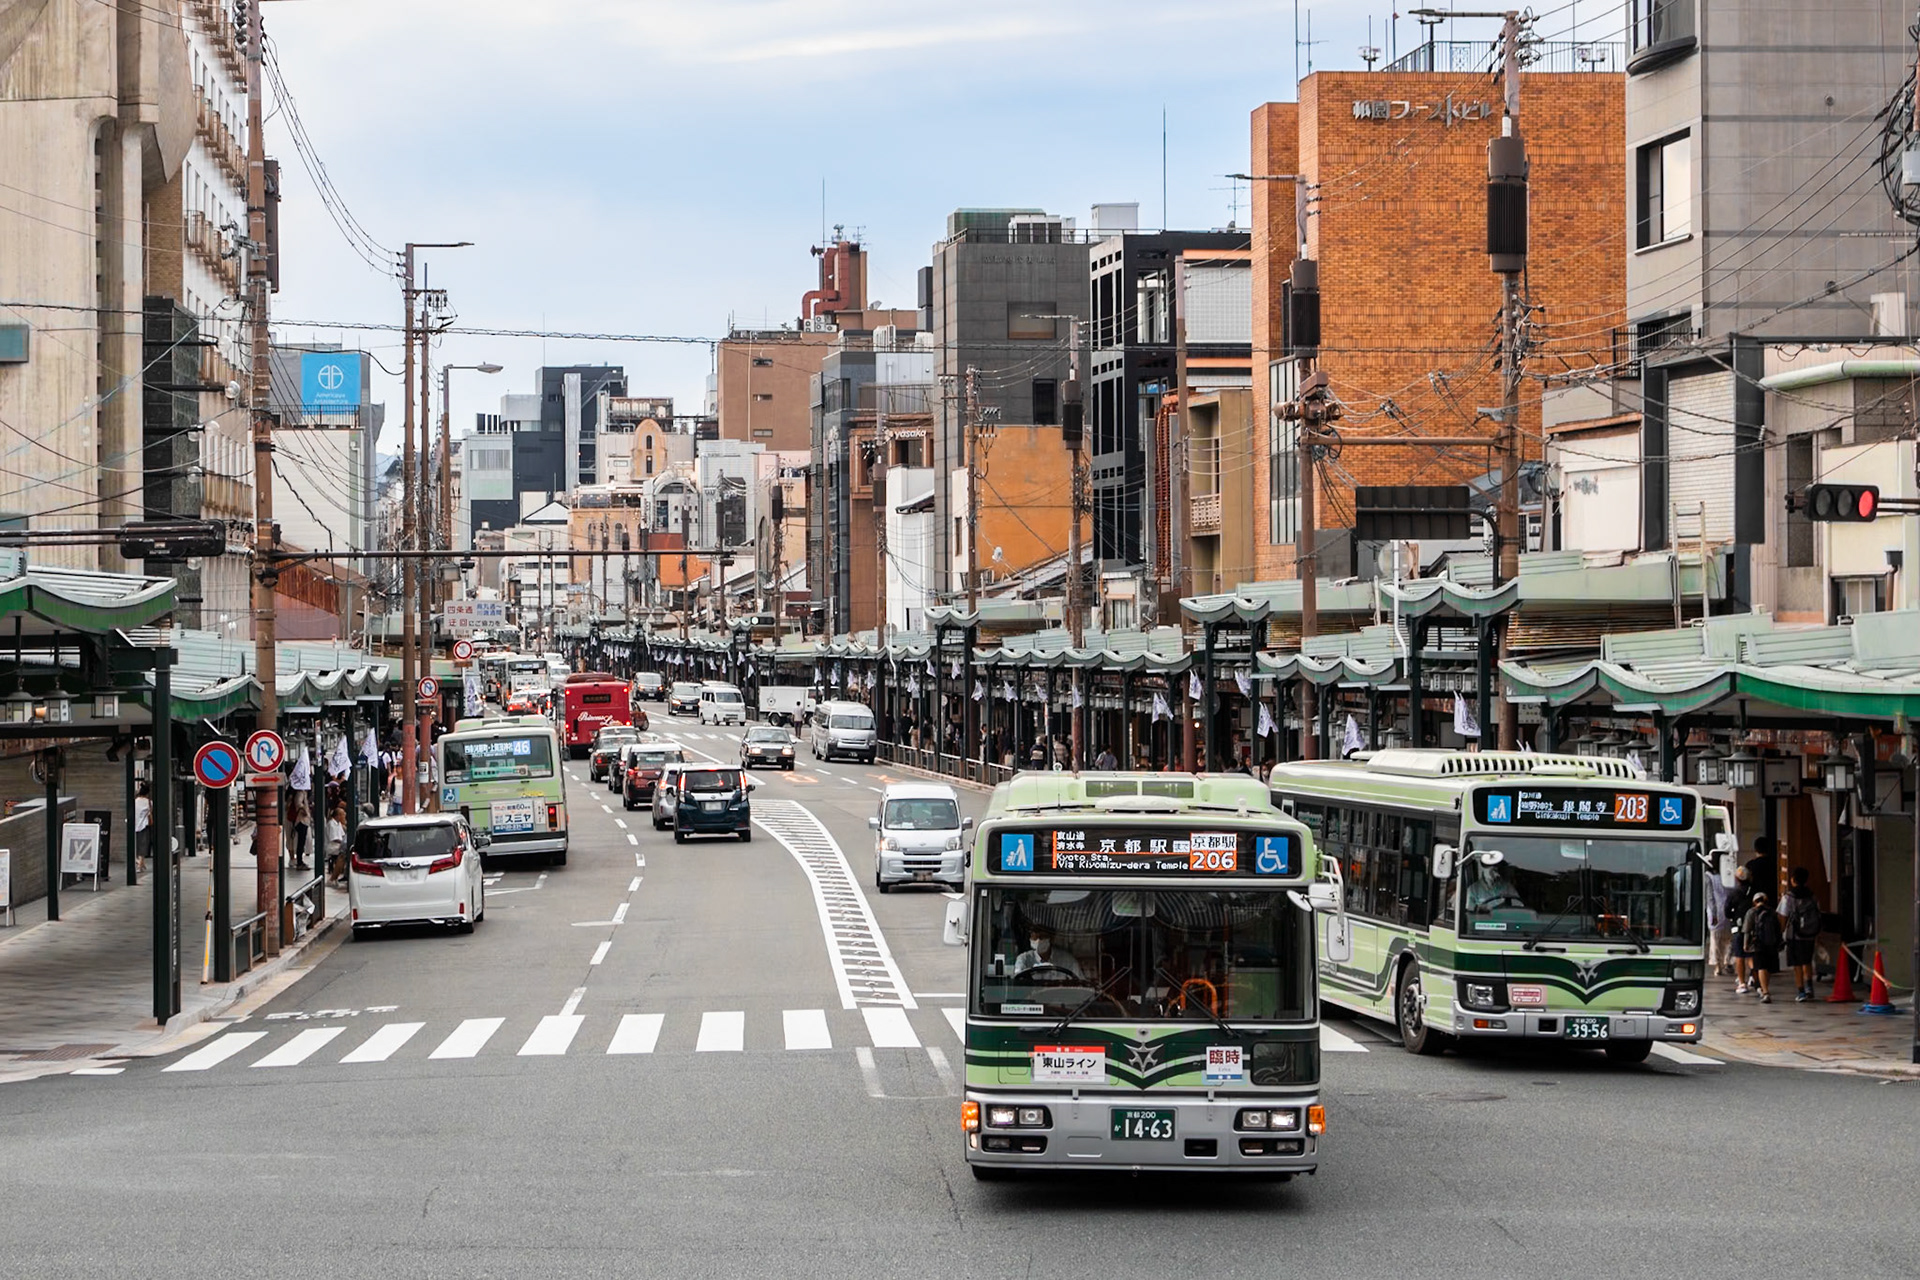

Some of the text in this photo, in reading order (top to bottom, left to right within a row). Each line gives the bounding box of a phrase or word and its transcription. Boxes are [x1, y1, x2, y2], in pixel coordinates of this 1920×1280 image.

[894, 426, 927, 440] yasaka
[447, 605, 473, 614] 四条通
[515, 741, 529, 754] 46
[1563, 800, 1607, 813] 銀閣寺
[1616, 796, 1648, 820] 203
[505, 813, 532, 823] スミヤ
[1057, 831, 1086, 841] 東山通
[1192, 835, 1236, 849] 京都駅
[1057, 841, 1086, 851] 清水寺
[1099, 838, 1168, 854] 京都駅
[1056, 853, 1113, 862] Kyoto Sta.
[1192, 851, 1235, 870] 206
[1058, 860, 1189, 870] Via Kiyomizu-dera Temple
[1572, 1023, 1608, 1038] 39-56
[1042, 1056, 1097, 1069] 東山ライン
[1209, 1049, 1240, 1065] 臨時
[1126, 1111, 1157, 1119] 京都200
[1124, 1118, 1173, 1139] 14-63
